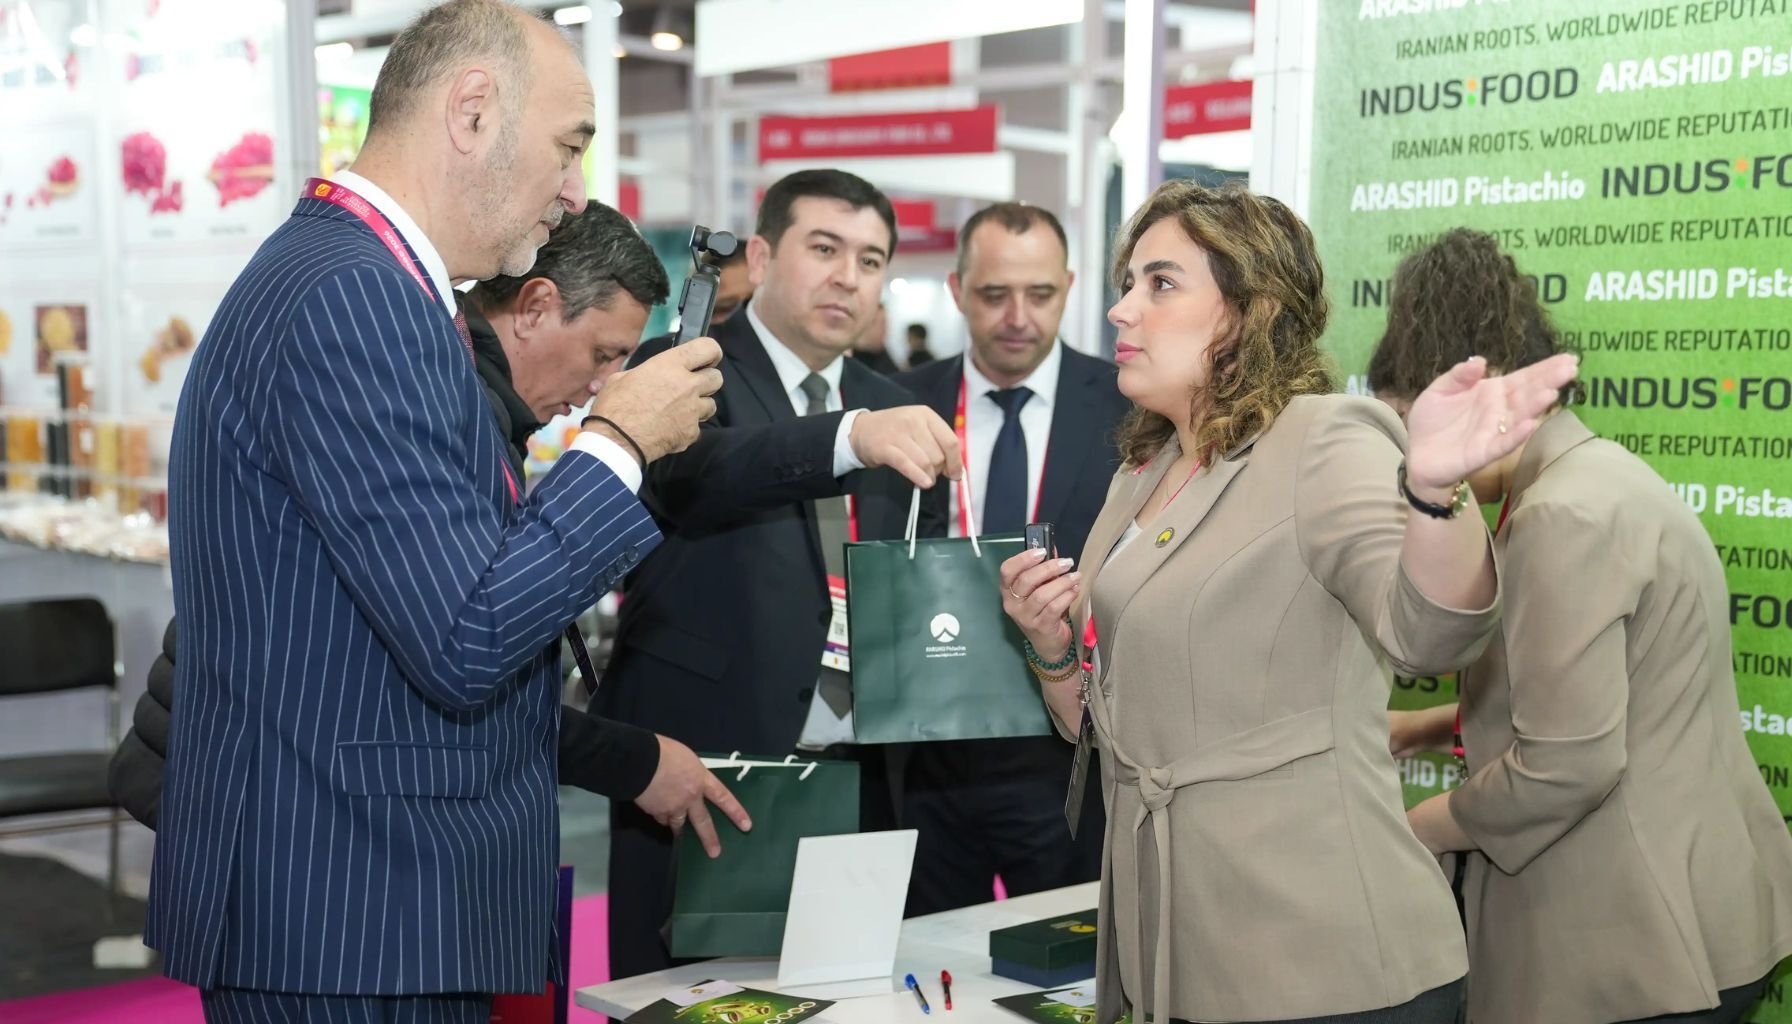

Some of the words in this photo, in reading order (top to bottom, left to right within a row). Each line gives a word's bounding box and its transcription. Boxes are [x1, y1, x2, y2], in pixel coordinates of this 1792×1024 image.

[1395, 33, 1468, 59] IRANIAN
[1546, 6, 1679, 42] WORLDWIDE
[1596, 49, 1733, 94] ARASHID
[1740, 45, 1792, 79] Pis
[1391, 135, 1464, 161] IRANIAN
[1468, 130, 1534, 155] ROOTS,
[1540, 117, 1671, 150] WORLDWIDE
[1677, 107, 1792, 138] REPUTATI
[1350, 177, 1459, 212] ARASHID
[1465, 171, 1585, 206] Pistachio
[1535, 221, 1664, 249] WORLDWIDE
[1585, 269, 1718, 302] ARASHID
[1726, 267, 1792, 299] Pist
